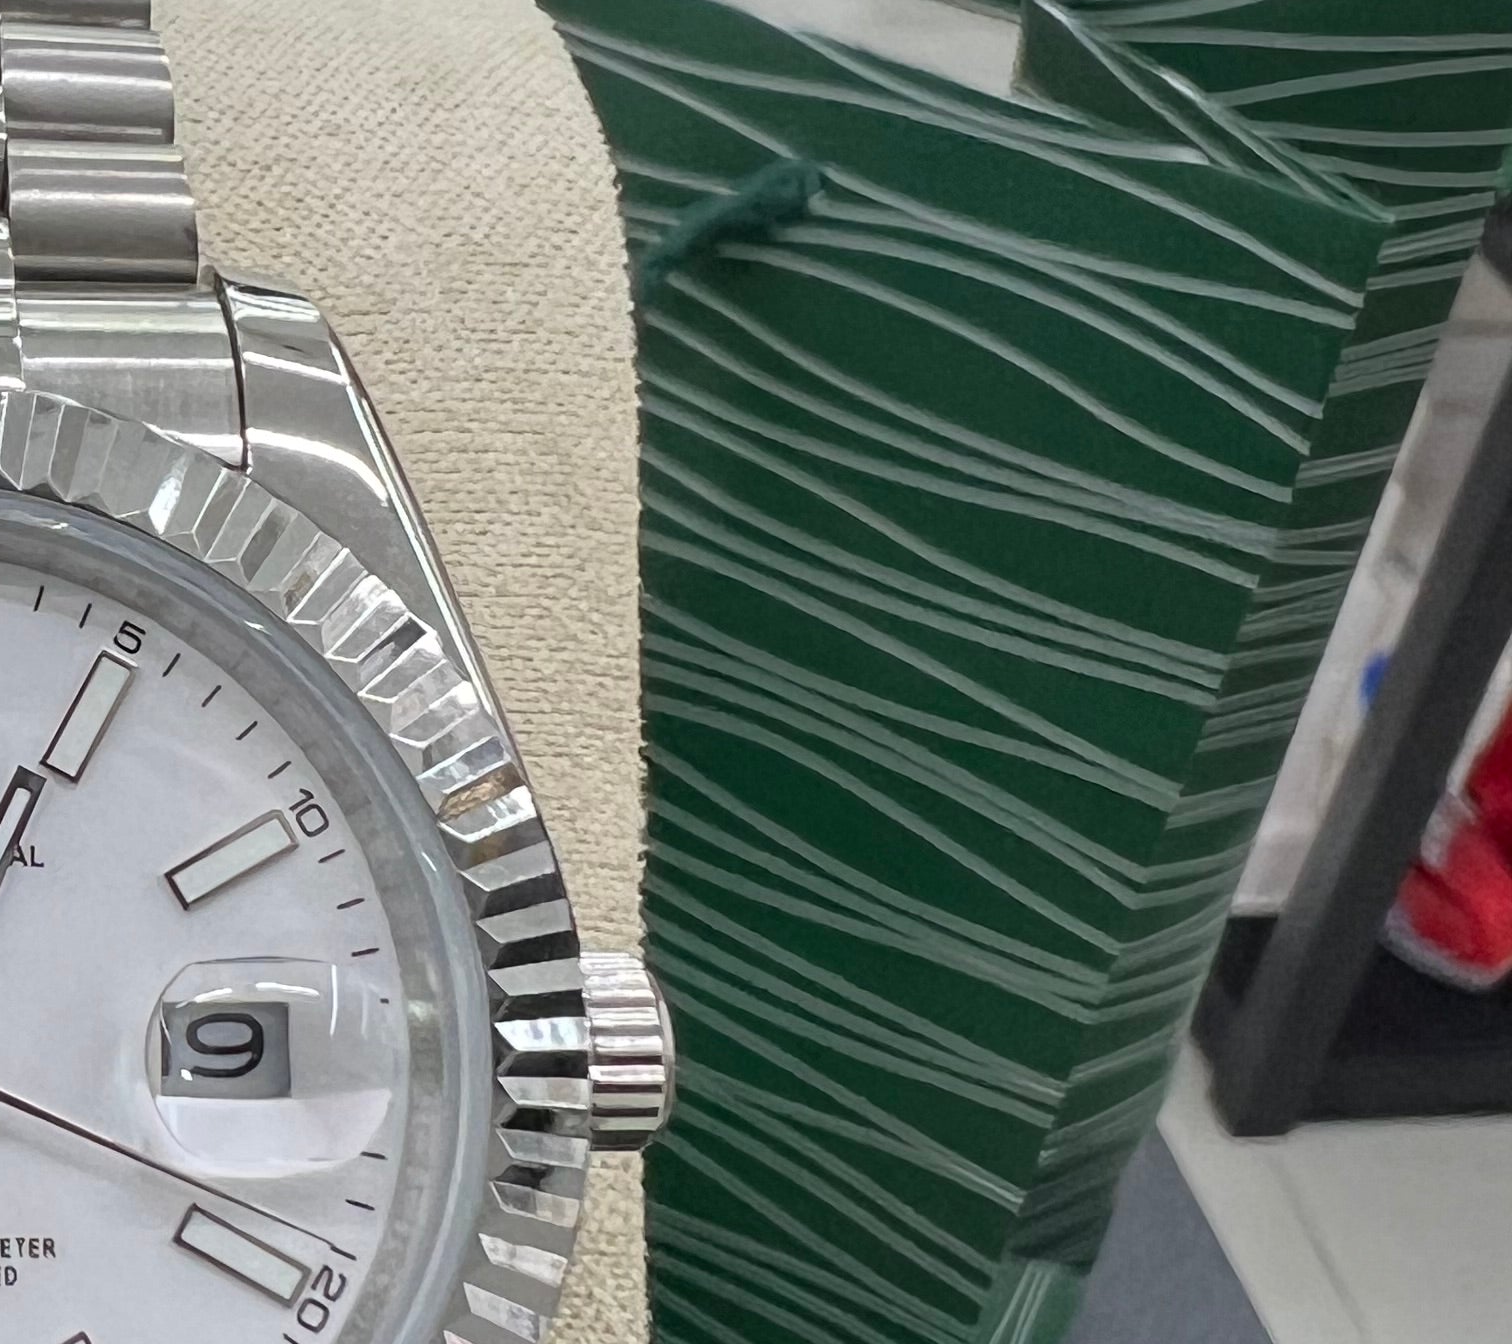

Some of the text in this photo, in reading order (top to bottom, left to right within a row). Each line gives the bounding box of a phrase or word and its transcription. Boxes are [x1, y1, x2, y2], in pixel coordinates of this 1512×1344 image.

[113, 620, 147, 655] 5
[288, 787, 330, 838] 10
[186, 1012, 265, 1078] 9
[295, 1264, 348, 1334] 20
